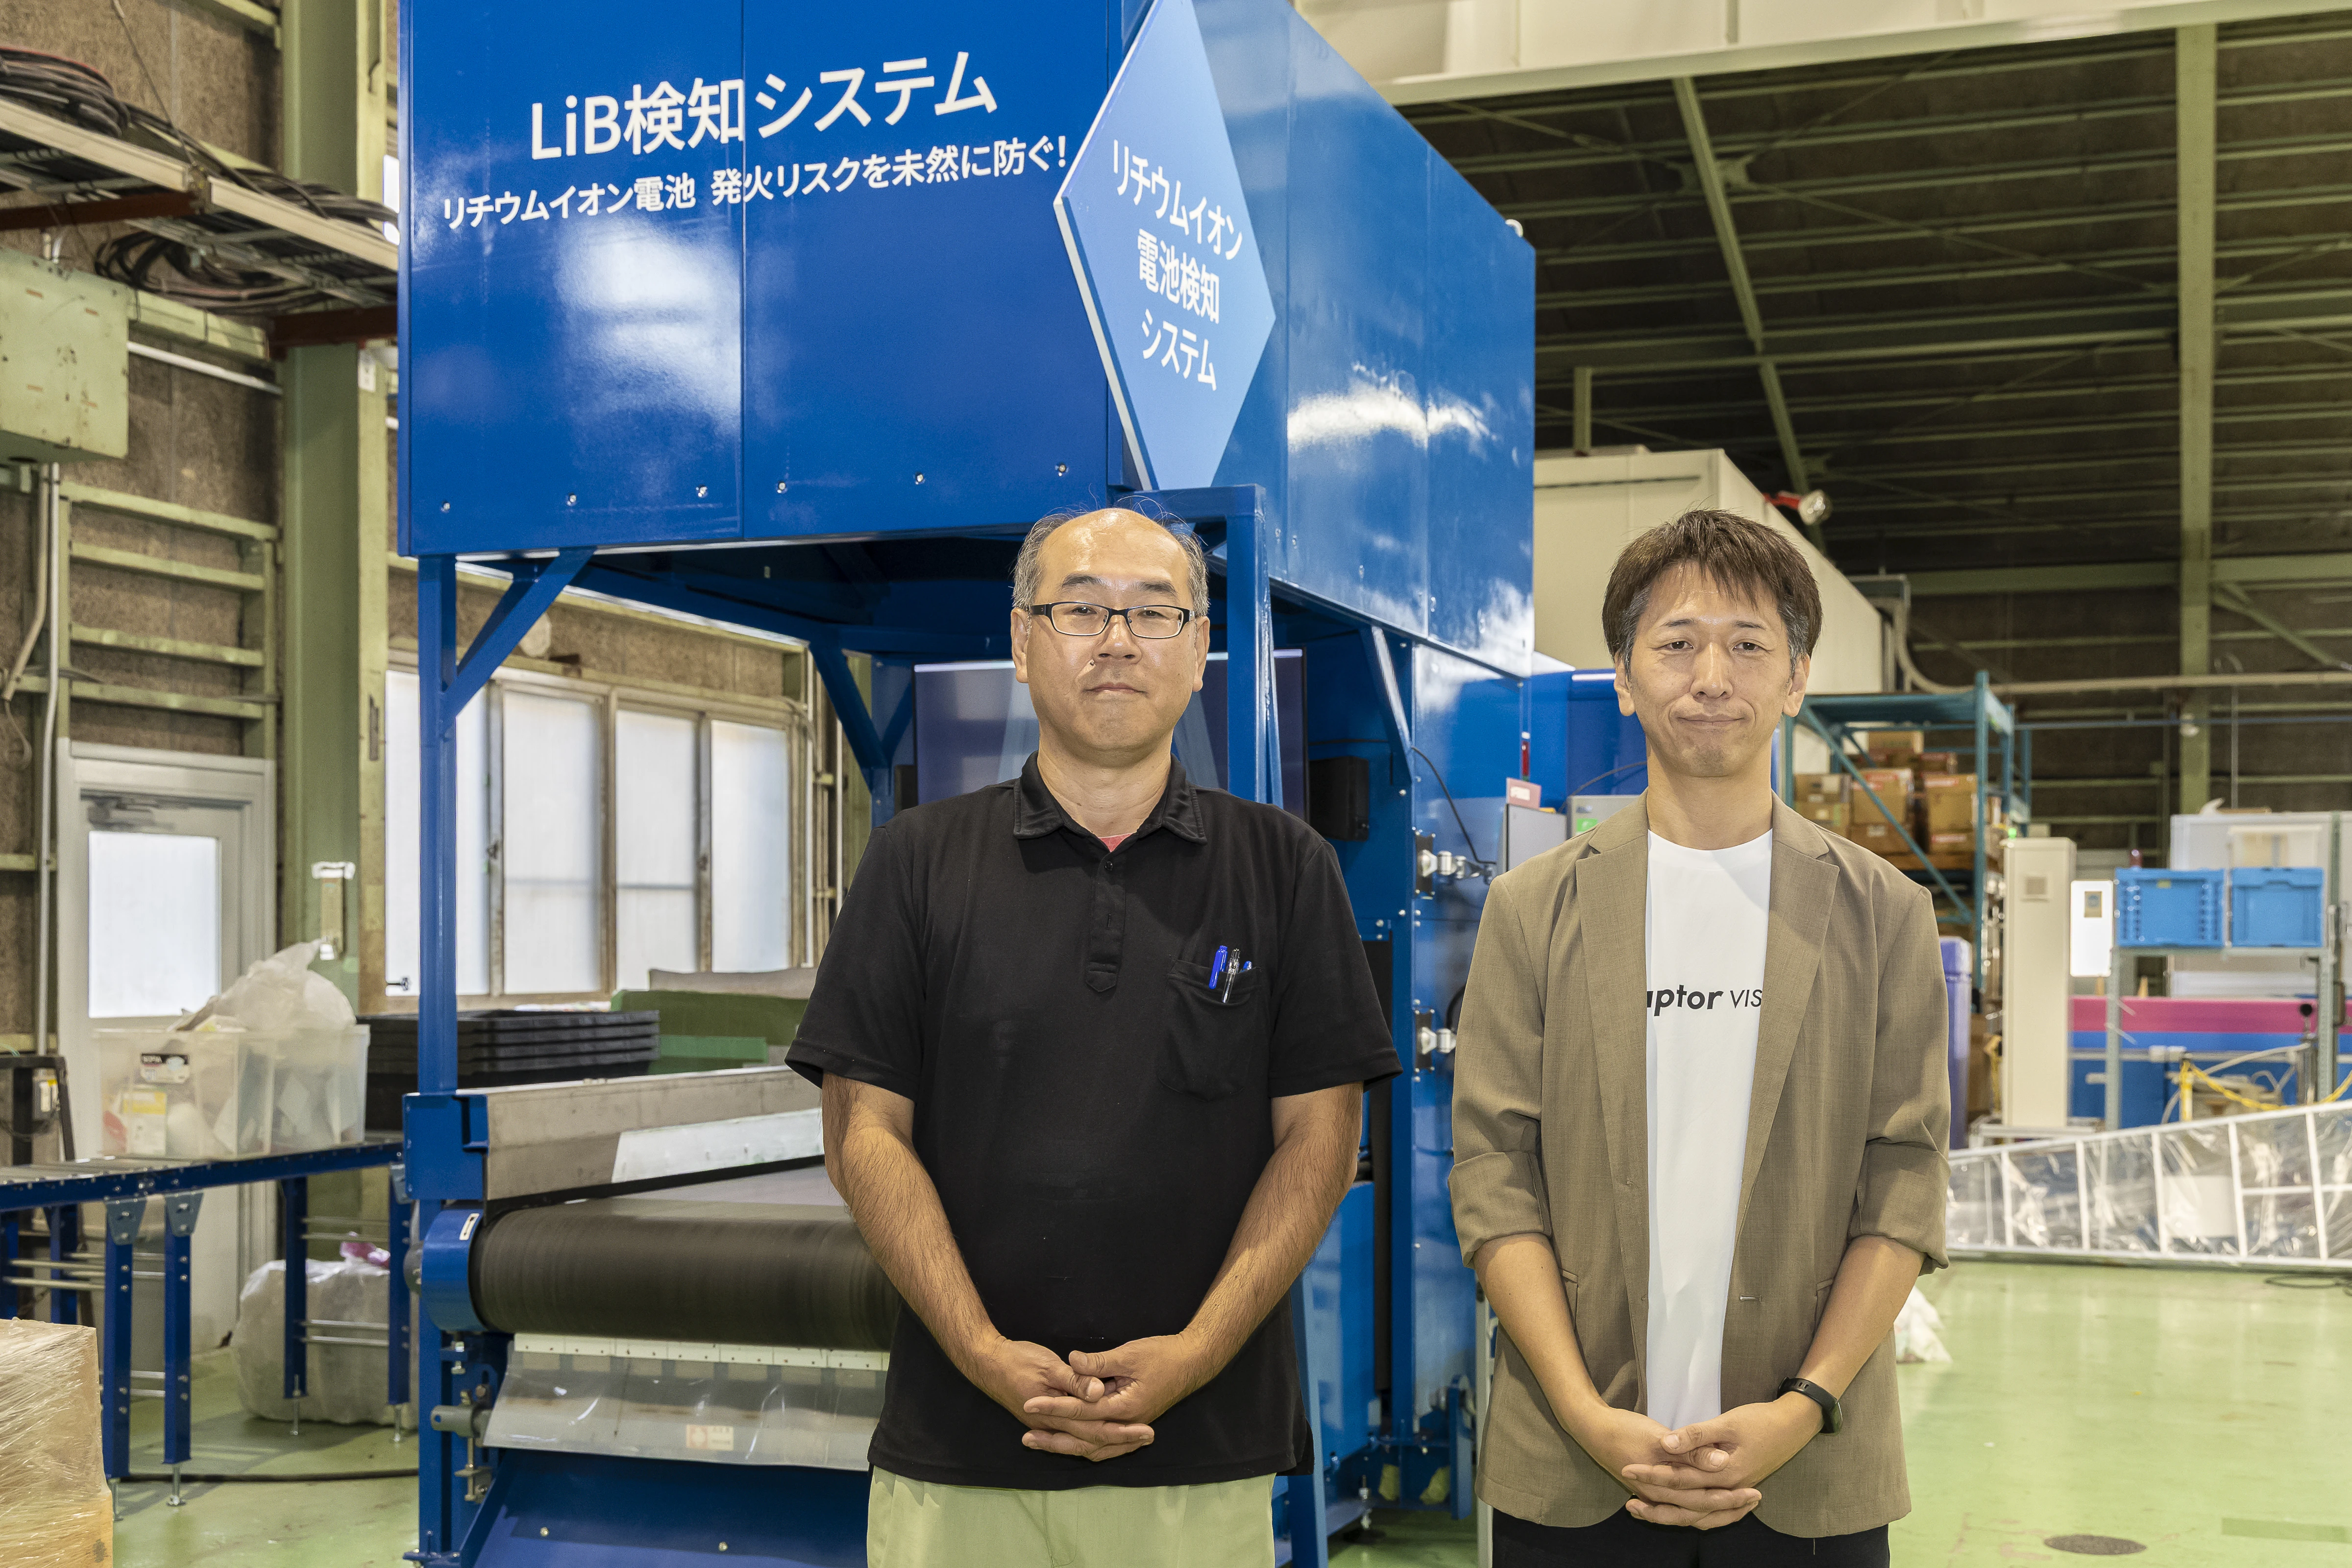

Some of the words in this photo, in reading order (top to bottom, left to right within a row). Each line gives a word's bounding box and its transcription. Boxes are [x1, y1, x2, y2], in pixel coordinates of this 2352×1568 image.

[532, 51, 997, 160] LiB検知システム
[442, 173, 696, 230] リチウムイオン電池
[1113, 139, 1243, 260] リチウムイオン
[1137, 228, 1220, 324] 電池検知
[1141, 308, 1217, 391] システム
